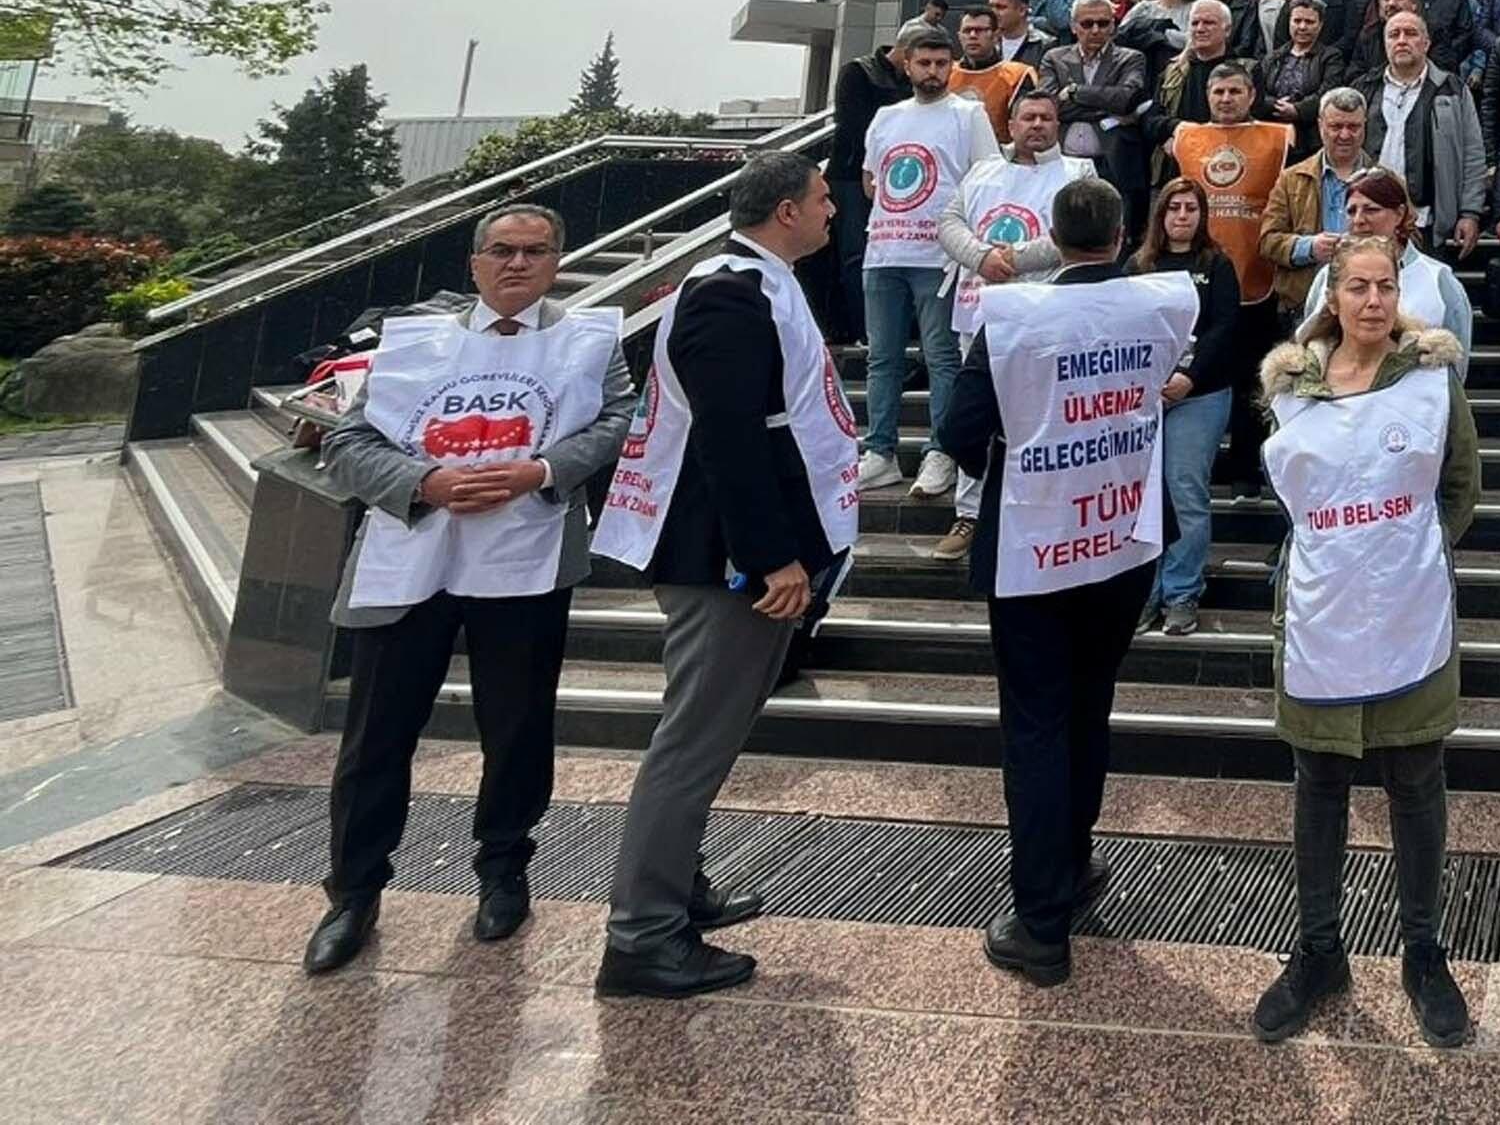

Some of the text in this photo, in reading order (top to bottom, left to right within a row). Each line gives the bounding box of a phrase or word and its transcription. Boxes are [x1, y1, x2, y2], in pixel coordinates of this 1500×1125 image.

[1057, 339, 1153, 382] EMEĞİMİZ
[443, 391, 531, 415] BASK
[1064, 381, 1145, 424] ÜLKEMİZ
[1020, 423, 1145, 474] GELECEĞİMİZ
[1072, 479, 1143, 528] TÜM
[1343, 494, 1413, 526] BEL-SEN
